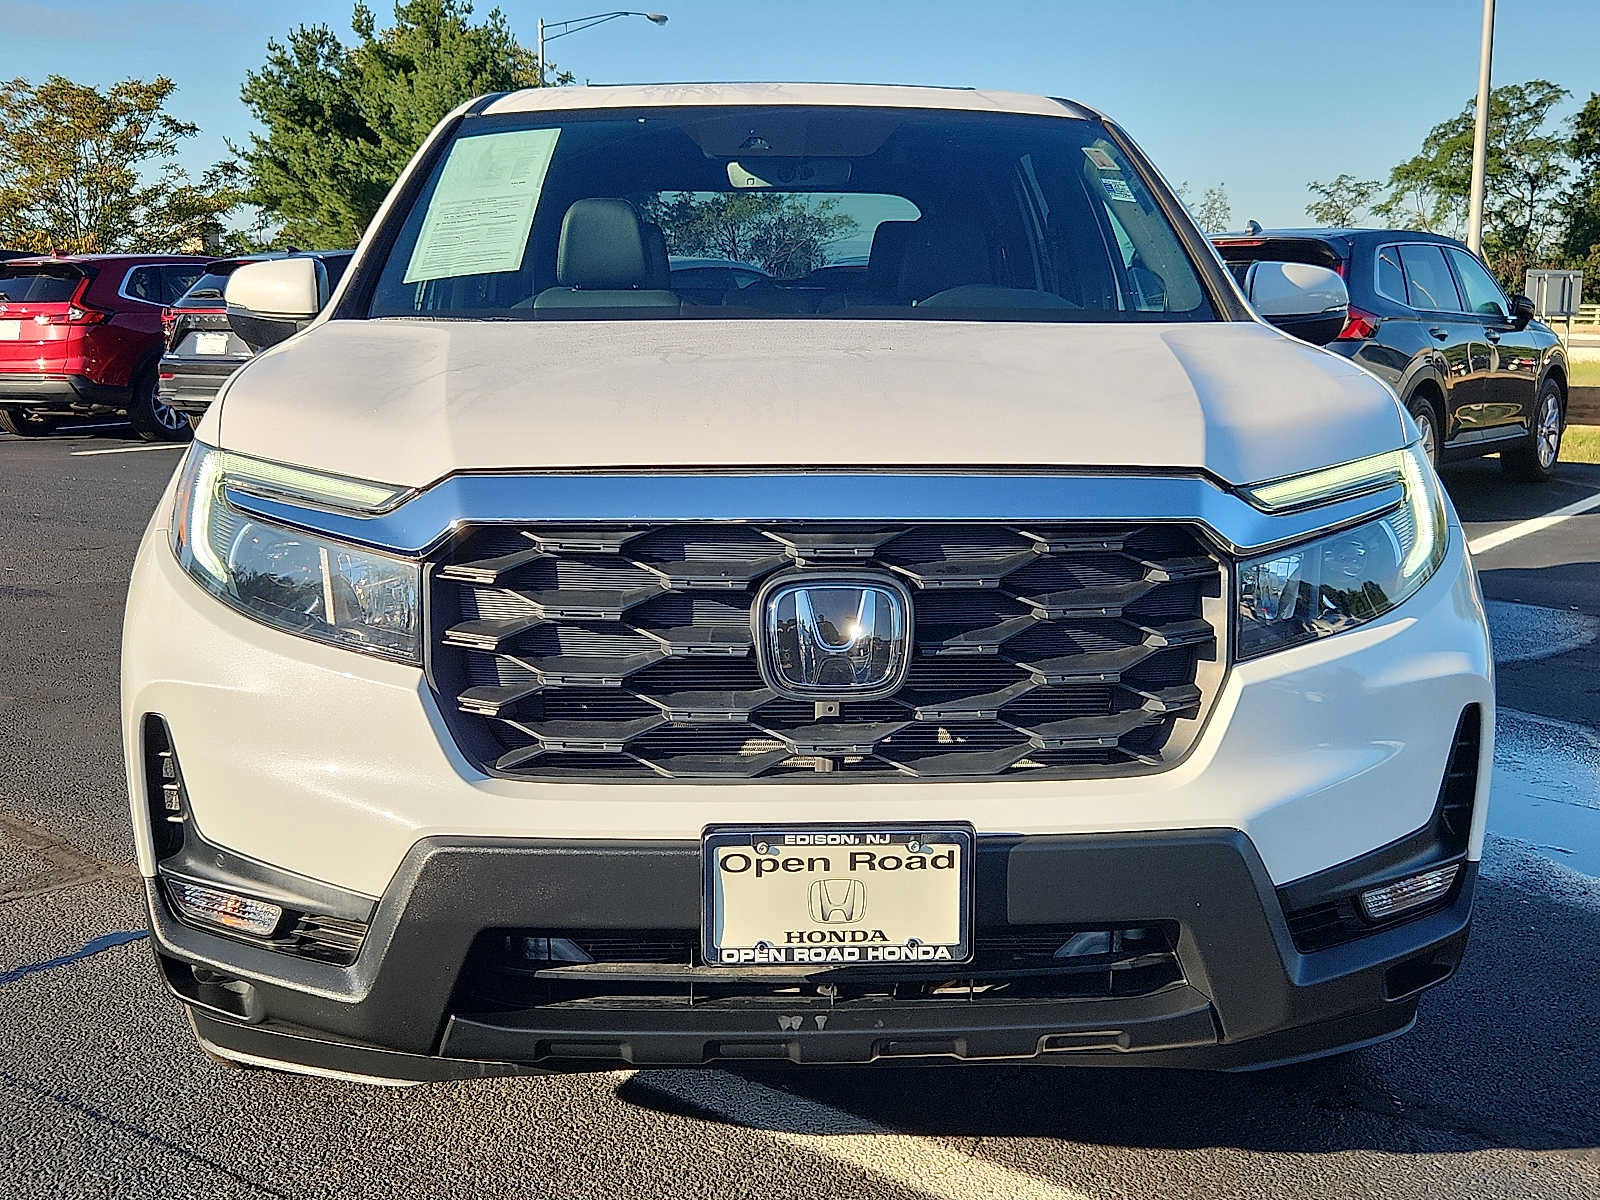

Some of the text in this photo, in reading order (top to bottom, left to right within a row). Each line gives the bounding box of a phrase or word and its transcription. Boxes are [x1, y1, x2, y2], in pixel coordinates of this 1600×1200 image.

[784, 834, 891, 845] EDISON, NJ
[719, 850, 955, 878] Open Road
[783, 930, 890, 944] HONDA
[721, 945, 952, 963] OPEN ROAD HONDA
